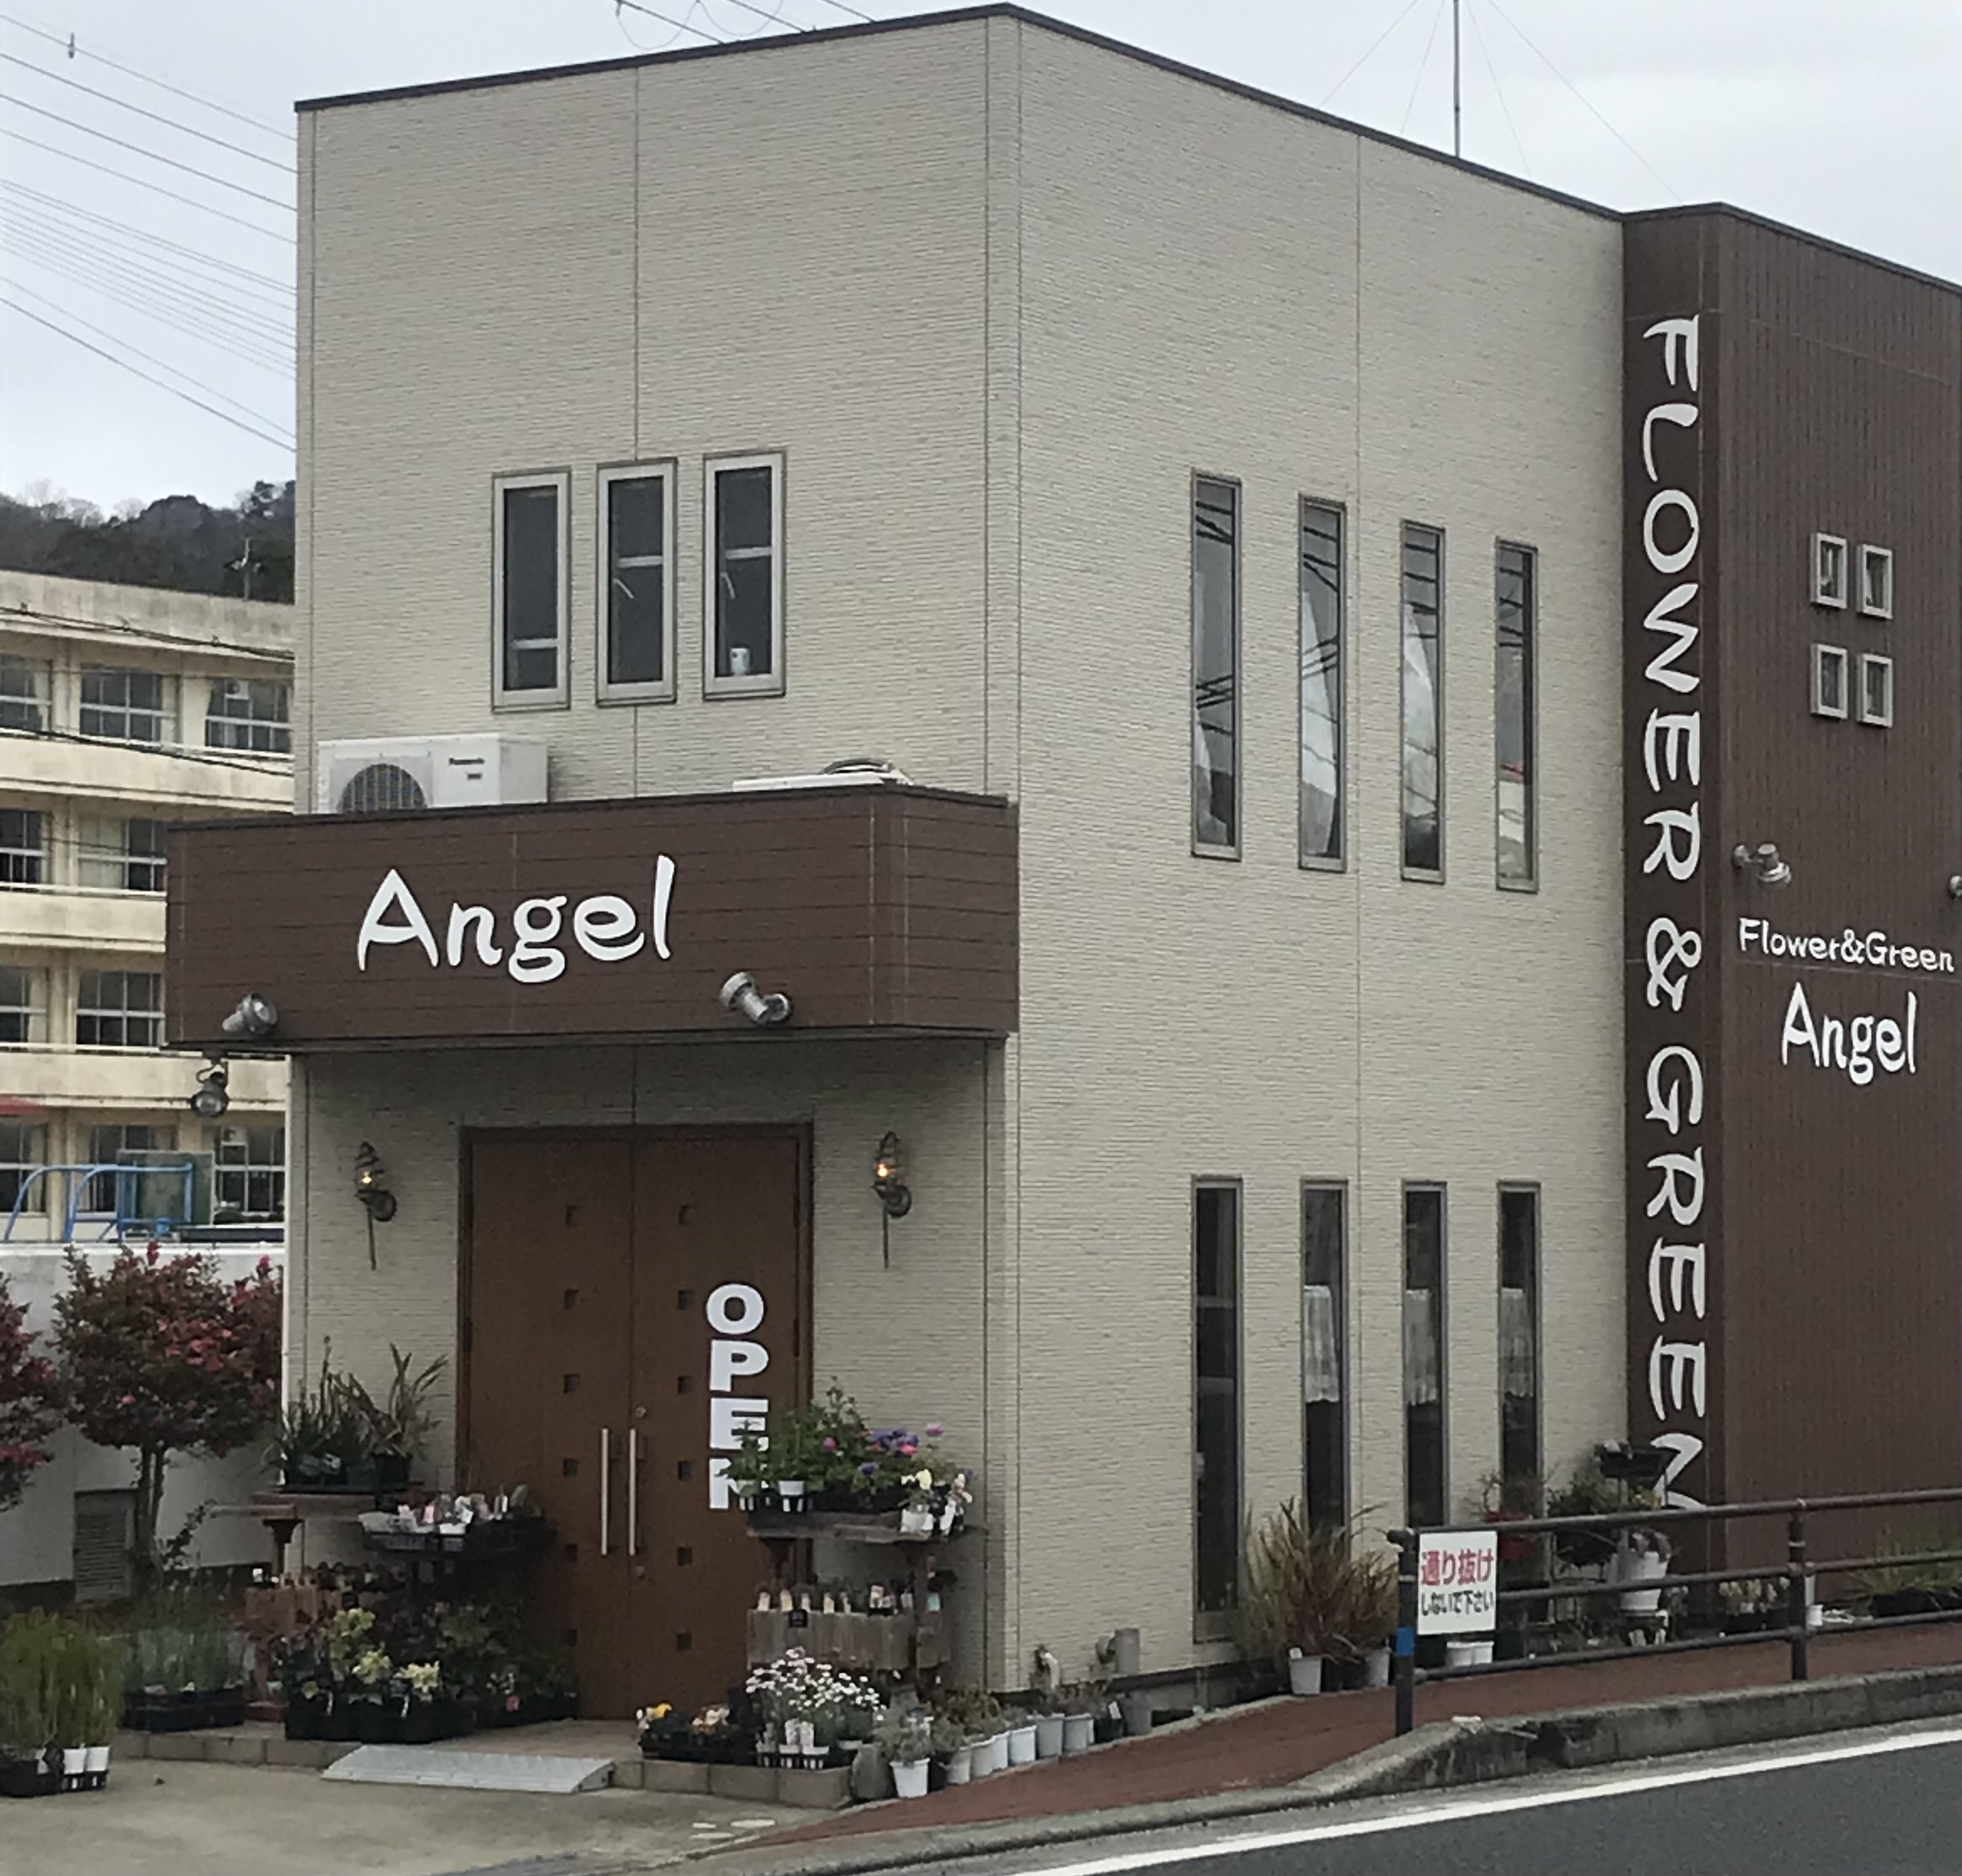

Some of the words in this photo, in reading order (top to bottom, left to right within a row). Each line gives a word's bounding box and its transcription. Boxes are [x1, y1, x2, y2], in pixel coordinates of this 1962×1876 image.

[1643, 314, 1700, 880] FLOWER
[357, 854, 675, 983] Angel
[1646, 917, 1702, 1012] &
[1739, 917, 1955, 973] Flower&Green
[1782, 981, 1917, 1085] Angel
[1421, 1548, 1494, 1585] 通り抜け
[1421, 1590, 1494, 1616] しないで下さい
